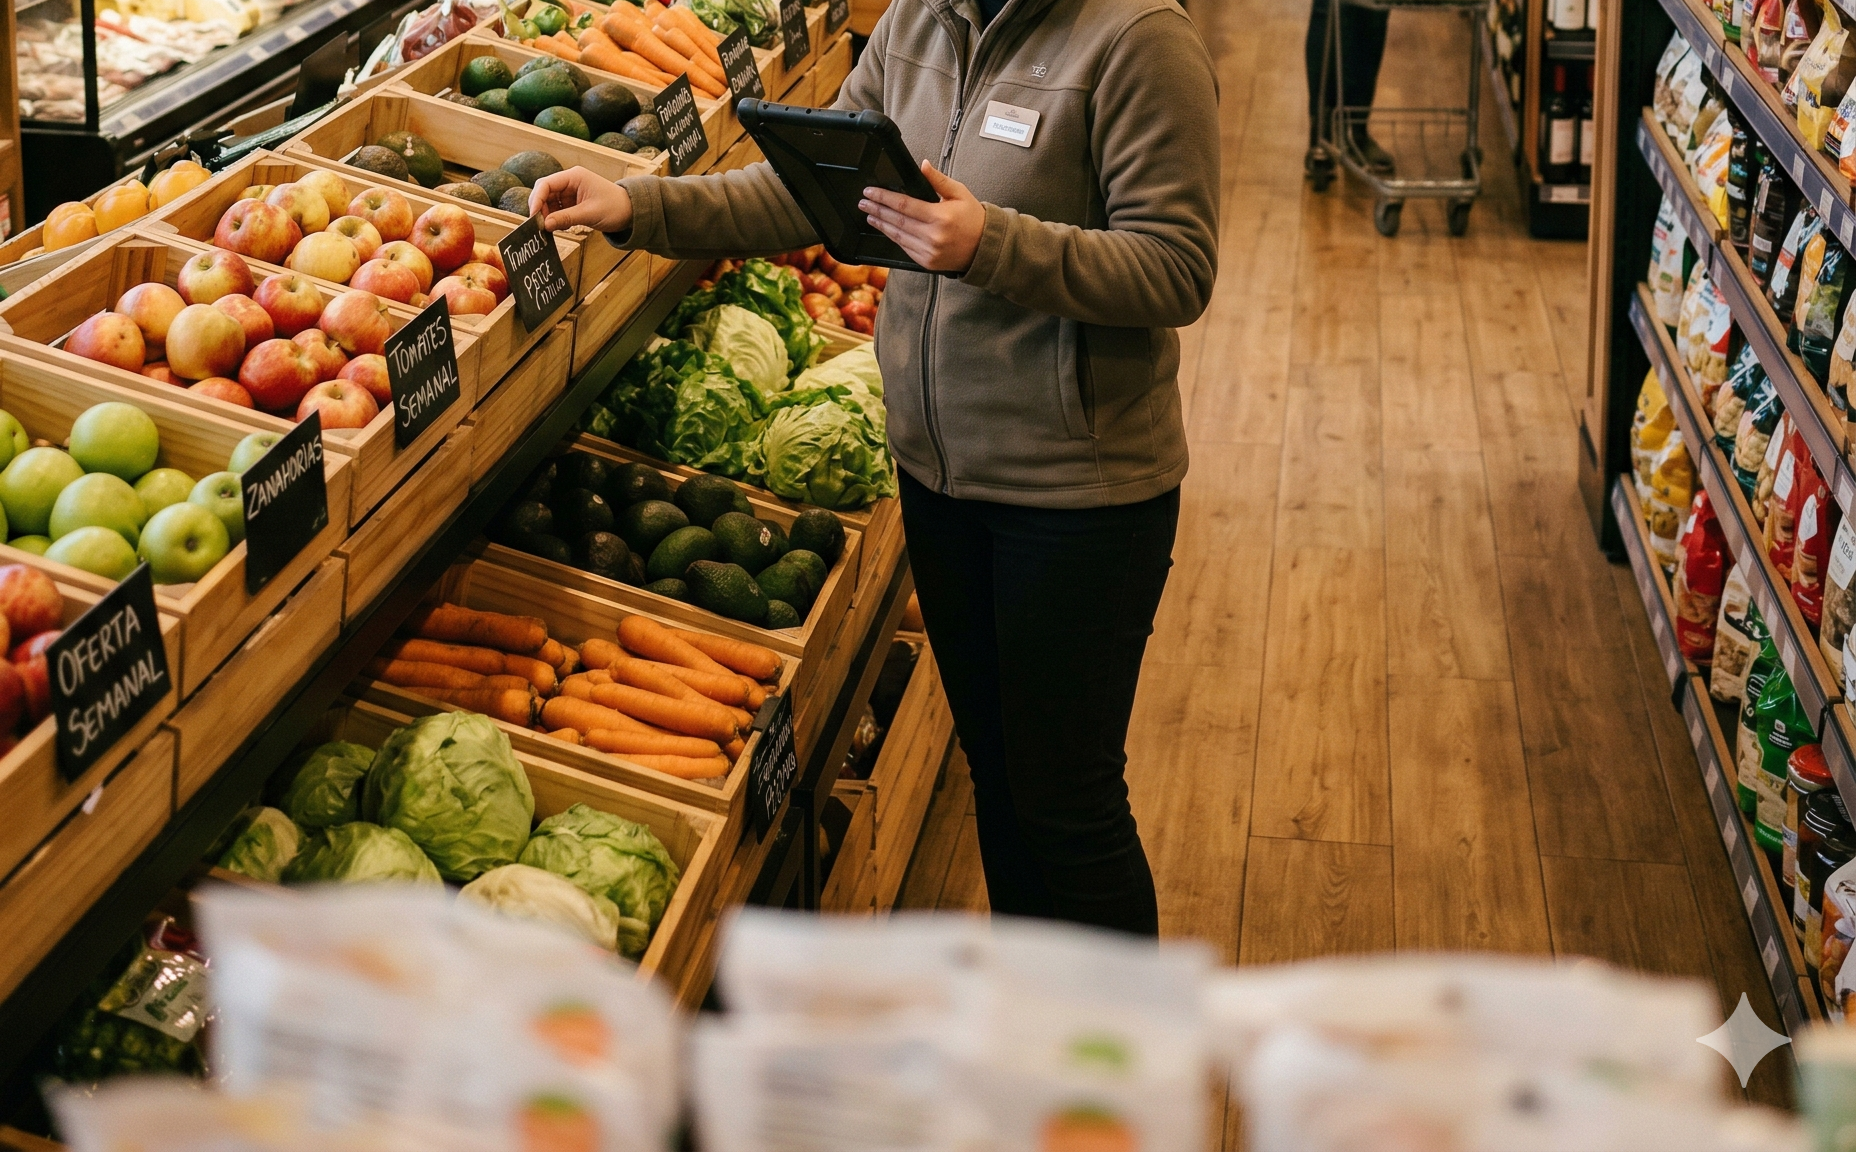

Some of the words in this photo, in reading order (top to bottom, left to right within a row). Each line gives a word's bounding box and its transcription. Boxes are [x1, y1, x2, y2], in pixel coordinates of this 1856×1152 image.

[388, 315, 447, 379] TOMATES
[399, 360, 458, 428] SEMANAL
[246, 434, 323, 521] ZANAHORIAS
[57, 604, 142, 696] OFERTA
[68, 650, 164, 756] SEMANAL
